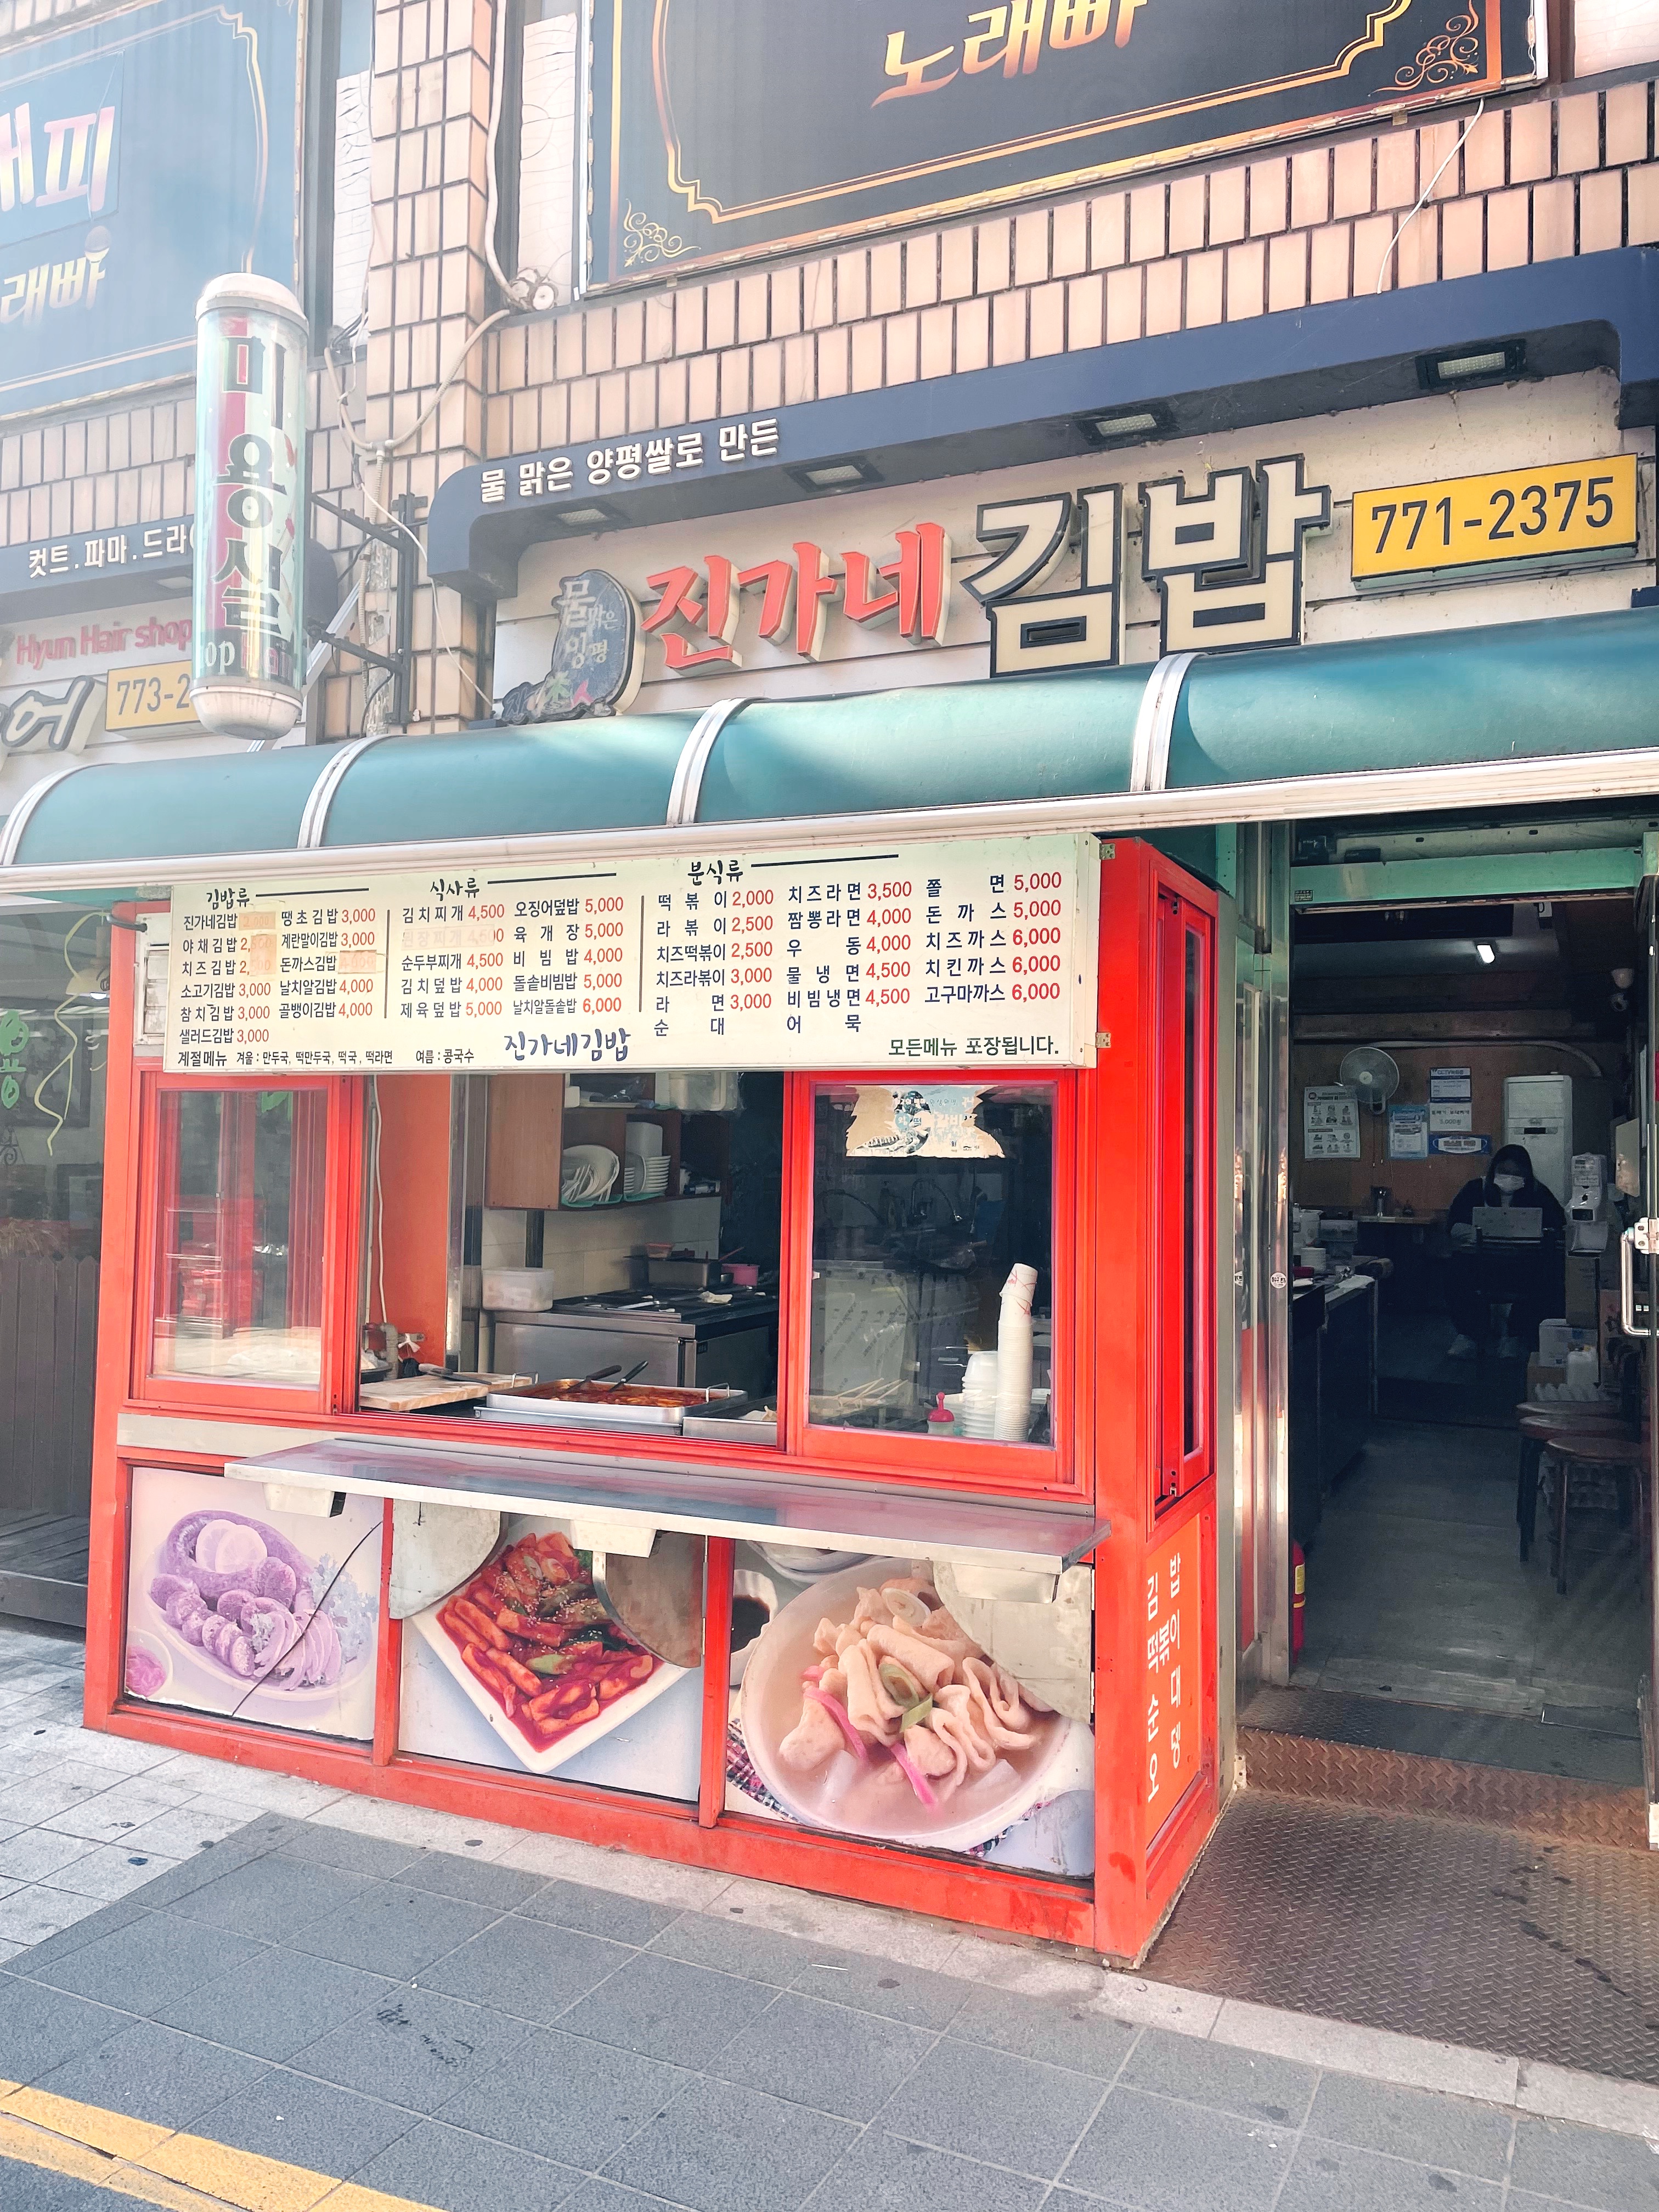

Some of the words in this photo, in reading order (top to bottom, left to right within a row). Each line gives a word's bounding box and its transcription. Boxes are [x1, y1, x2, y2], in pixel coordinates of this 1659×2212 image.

[481, 468, 506, 504] 물
[519, 456, 573, 496] 맑은
[587, 432, 704, 486] 양평쌀로
[719, 418, 779, 462] 만든
[1371, 476, 1615, 555] 771-2375
[641, 522, 945, 670] 진가네
[960, 453, 1333, 678] 김밥
[16, 634, 76, 670] Hyun
[80, 620, 132, 656] Hair
[135, 616, 193, 652] shop
[687, 860, 743, 885] 분식류
[1014, 871, 1062, 893] 5,000
[206, 888, 249, 910] 김밥류
[430, 878, 479, 901] 식사류
[732, 889, 774, 909] 2,000
[867, 881, 912, 901] 3,500
[342, 908, 375, 924] 3,000
[468, 904, 505, 921] 4,500
[515, 898, 580, 917] 오징어덮밥
[585, 896, 624, 915] 5,000
[1013, 899, 1061, 920] 5,000
[184, 913, 237, 930] 진가네김밥
[732, 915, 773, 934] 2,500
[866, 908, 911, 927] 4,000
[281, 931, 338, 949] 계란말이김밥
[341, 932, 375, 948] 3,000
[585, 922, 624, 940] 5,000
[1013, 927, 1060, 948] 6,000
[657, 943, 726, 963] 치즈떡볶이
[731, 941, 772, 960] 2,500
[866, 934, 911, 953] 4,000
[280, 956, 337, 972] 돈까스김밥
[402, 953, 462, 971] 순두부찌개
[467, 952, 503, 970] 4,500
[584, 947, 623, 966] 4,000
[1012, 955, 1060, 975] 6,000
[657, 968, 725, 988] 치즈라볶이
[731, 967, 772, 986] 3,000
[866, 961, 911, 980] 4,500
[181, 982, 235, 998] 소고기김밥
[239, 983, 270, 998] 3,000
[280, 979, 337, 996] 날치알김밥
[340, 979, 373, 995] 4,000
[466, 977, 503, 994] 4,000
[513, 972, 578, 991] 돌솥비빔밥
[584, 973, 623, 990] 5,000
[730, 993, 772, 1012] 3,000
[865, 988, 910, 1007] 4,500
[924, 983, 1006, 1004] 고구마까스
[1012, 983, 1060, 1003] 6,000
[238, 1006, 270, 1021] 3,000
[279, 1002, 336, 1019] 골뱅이김밥
[338, 1002, 373, 1018] 4,000
[466, 1001, 502, 1018] 5,000
[583, 997, 622, 1015] 6,000
[179, 1028, 234, 1044] 샐러드김밥
[237, 1029, 269, 1045] 3,000
[504, 1028, 631, 1062] 진가네김밥
[889, 1037, 957, 1056] 모든메뉴
[966, 1035, 1059, 1056] 포장됩니다.
[178, 1051, 227, 1066] 계절메뉴
[366, 1050, 393, 1065] 떡라면
[443, 1048, 475, 1064] 콩국수
